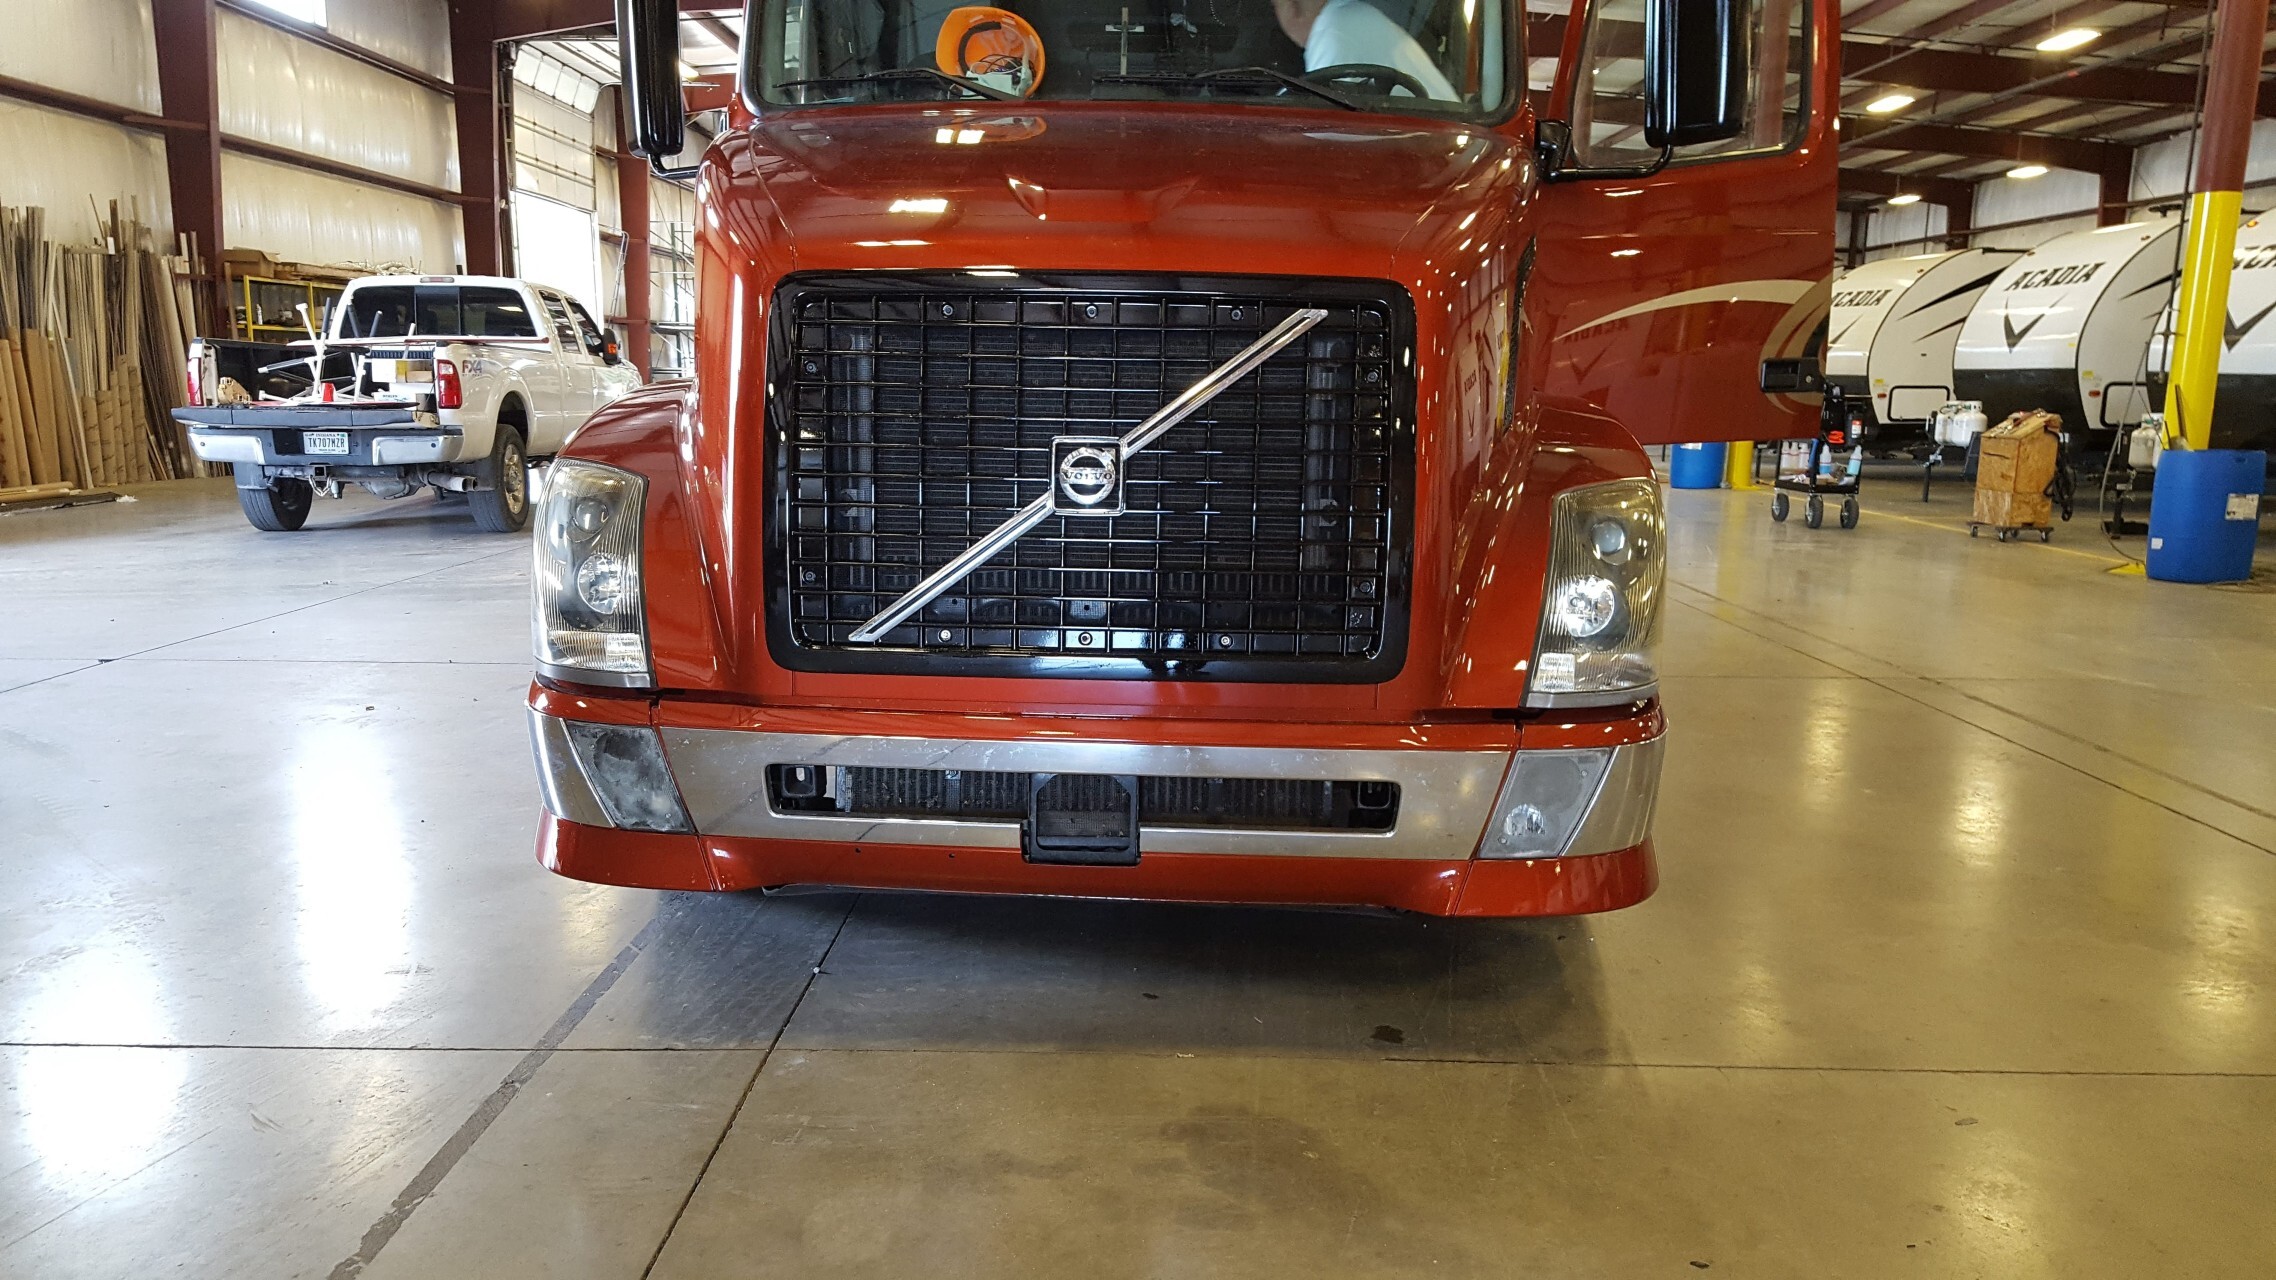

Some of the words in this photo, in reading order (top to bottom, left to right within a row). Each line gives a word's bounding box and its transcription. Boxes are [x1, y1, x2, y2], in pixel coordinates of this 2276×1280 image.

[2004, 262, 2106, 291] ACADIA
[462, 360, 482, 373] FX4
[1062, 471, 1113, 480] VOLVO
